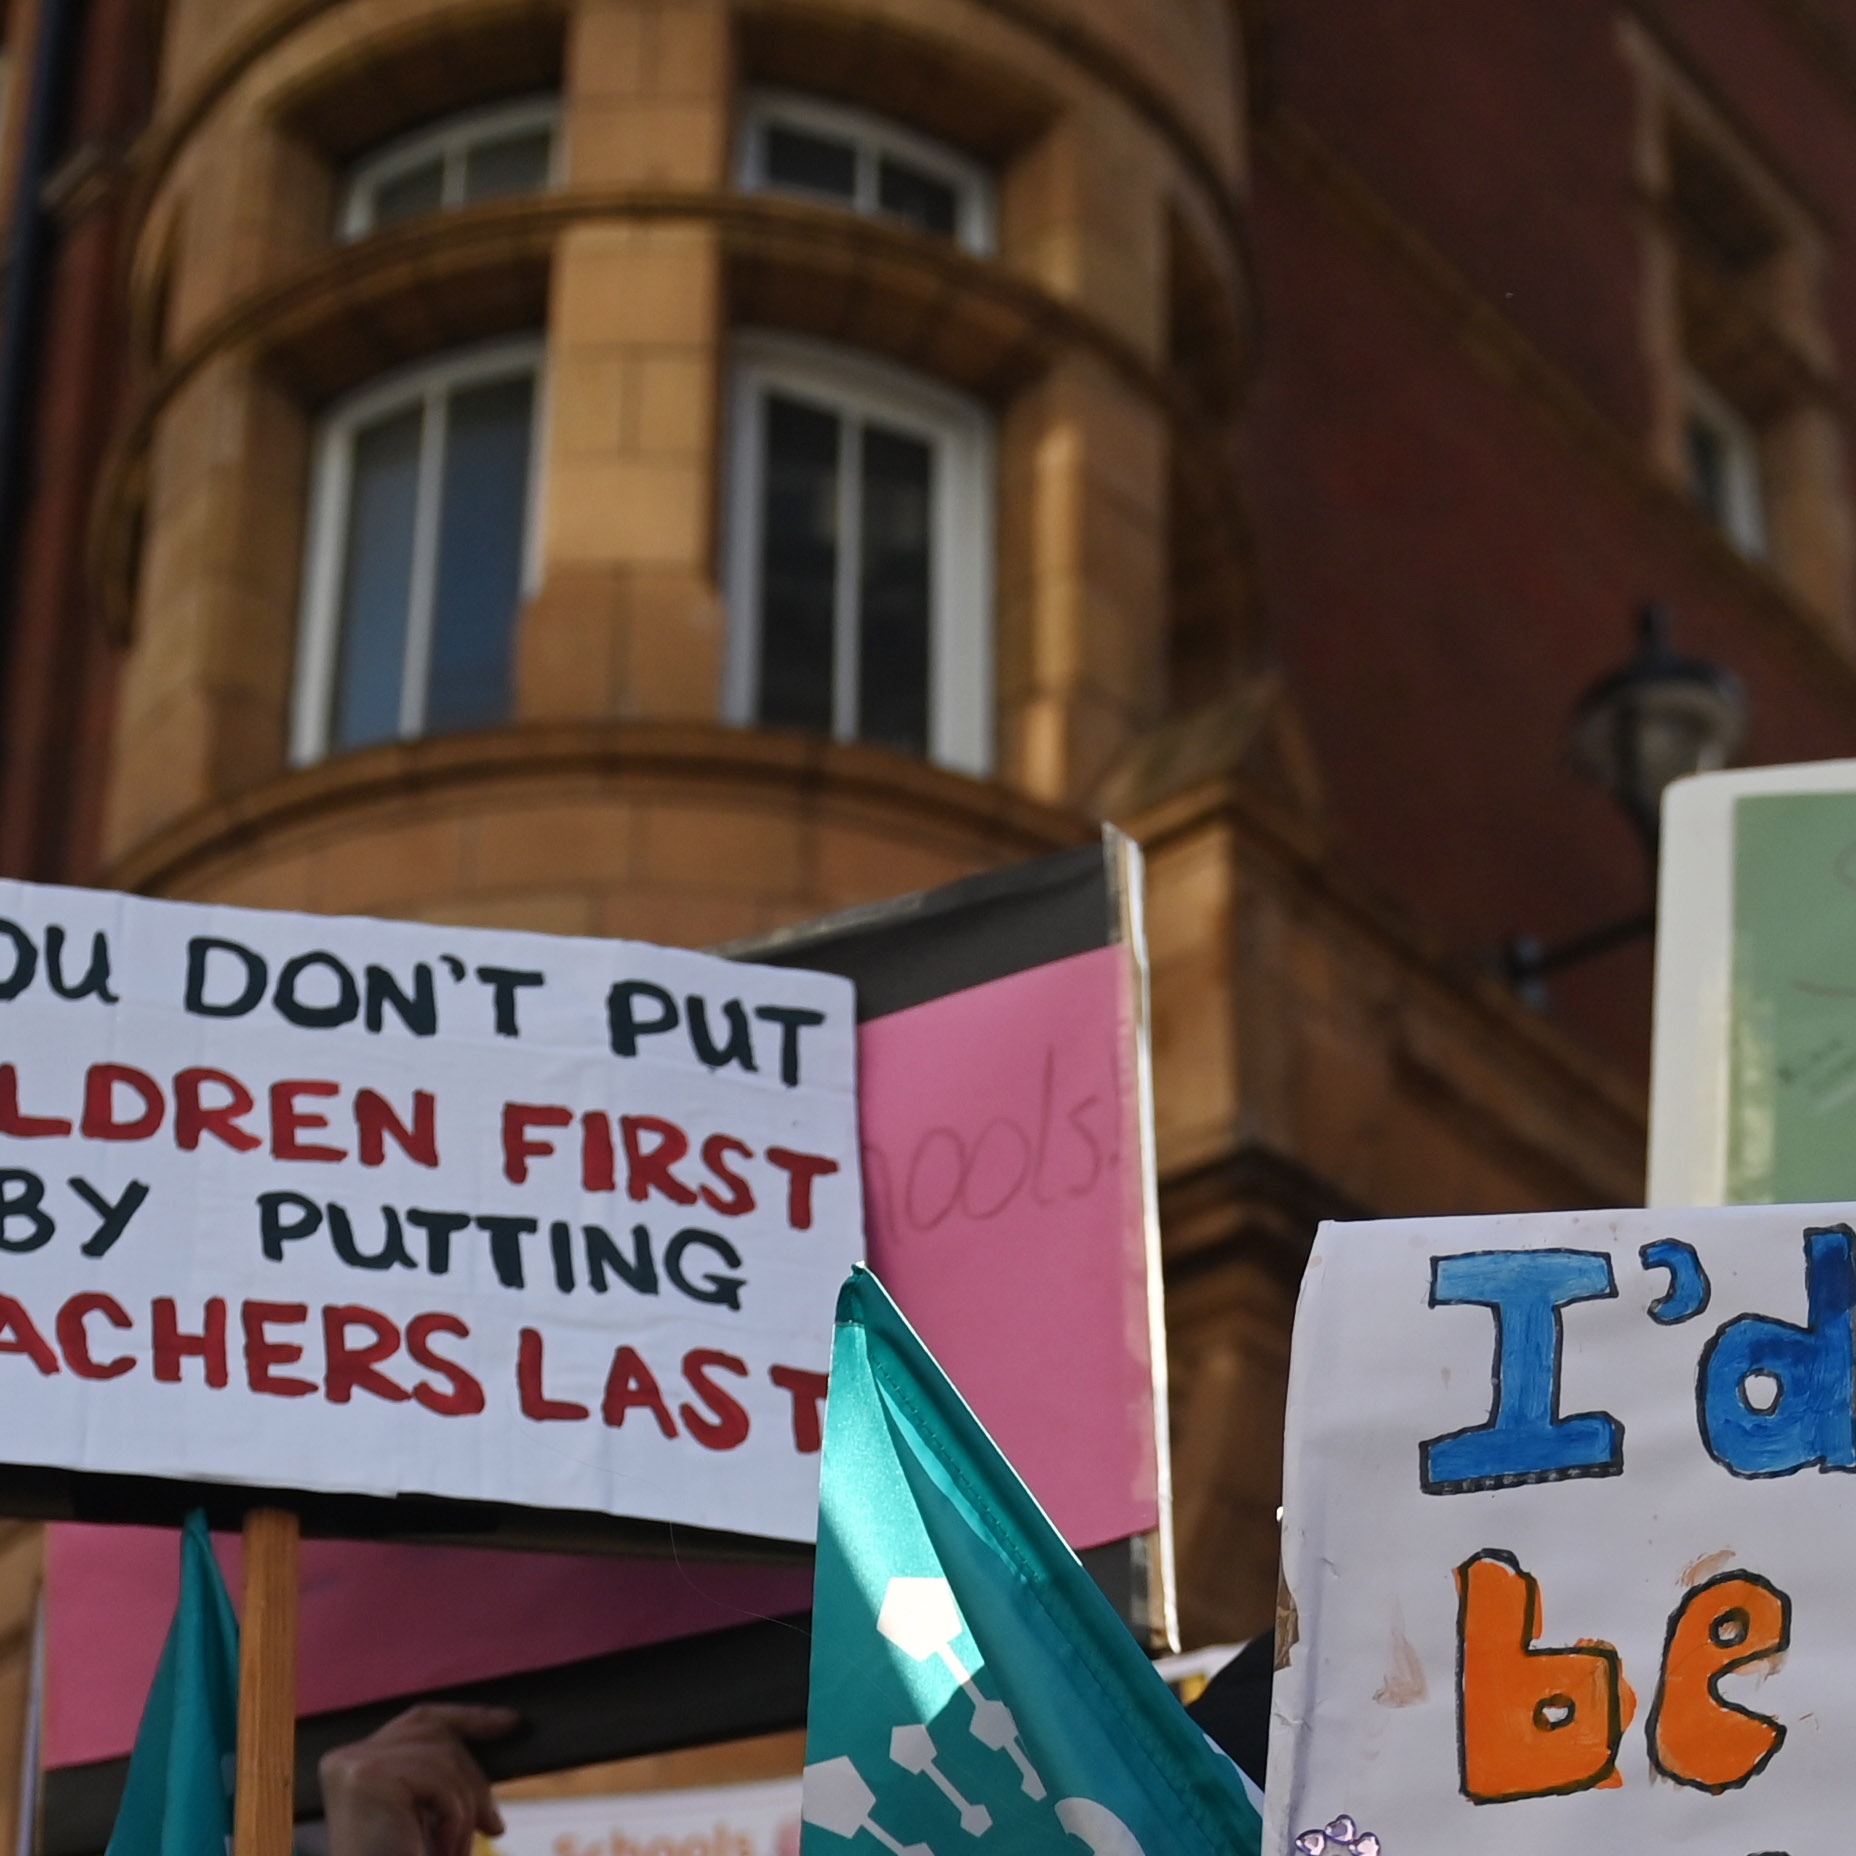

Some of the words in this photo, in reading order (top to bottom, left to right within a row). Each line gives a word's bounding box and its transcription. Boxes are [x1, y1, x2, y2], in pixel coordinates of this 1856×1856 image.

[186, 938, 544, 1037] DON'T
[608, 981, 824, 1087] PUT
[503, 1104, 838, 1230] FIRST
[258, 1192, 746, 1310] PUTTING
[517, 1329, 829, 1453] LAST
[1454, 1548, 1794, 1806] be
